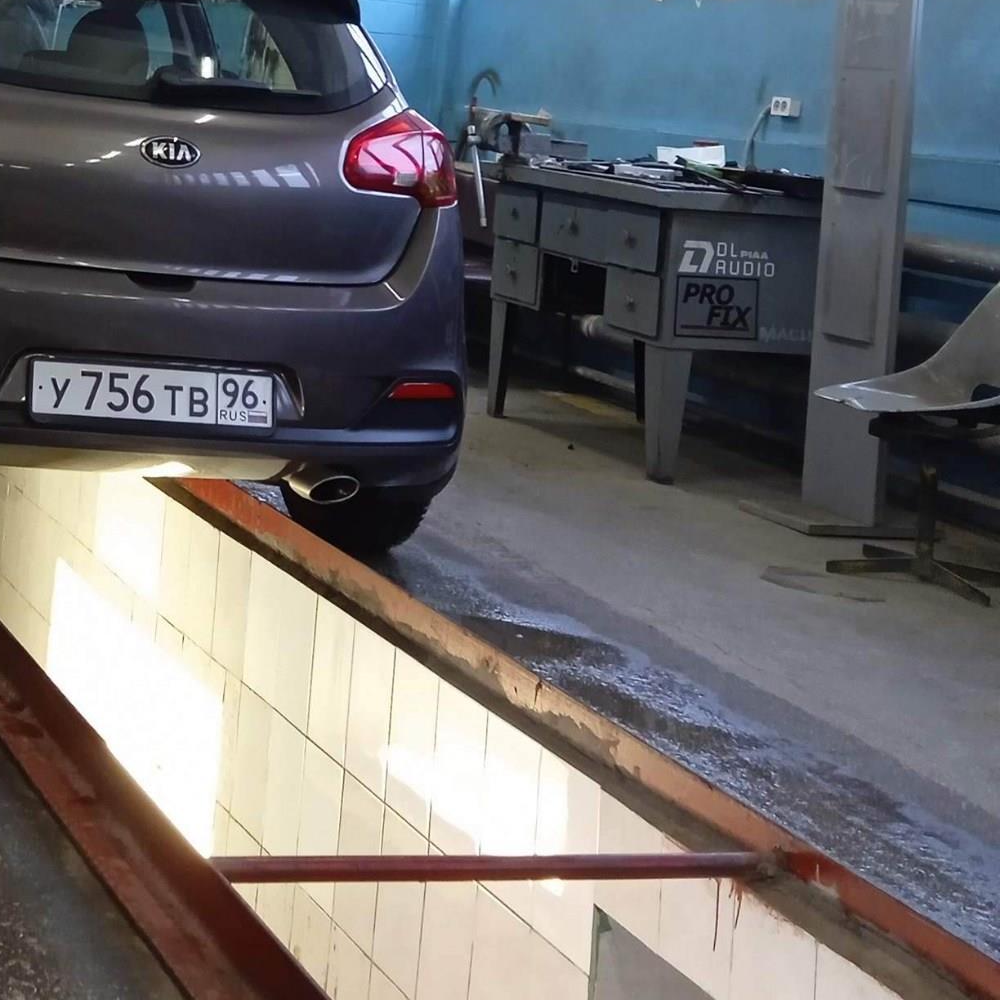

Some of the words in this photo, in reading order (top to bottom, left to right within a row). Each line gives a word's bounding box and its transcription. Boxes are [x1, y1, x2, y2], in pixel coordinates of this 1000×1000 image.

[151, 141, 193, 162] KIA
[716, 242, 739, 258] DL
[715, 259, 776, 278] AUDIO
[682, 282, 735, 306] PRO
[706, 304, 753, 329] FIX
[222, 378, 259, 409] 96
[219, 409, 248, 422] RUS
